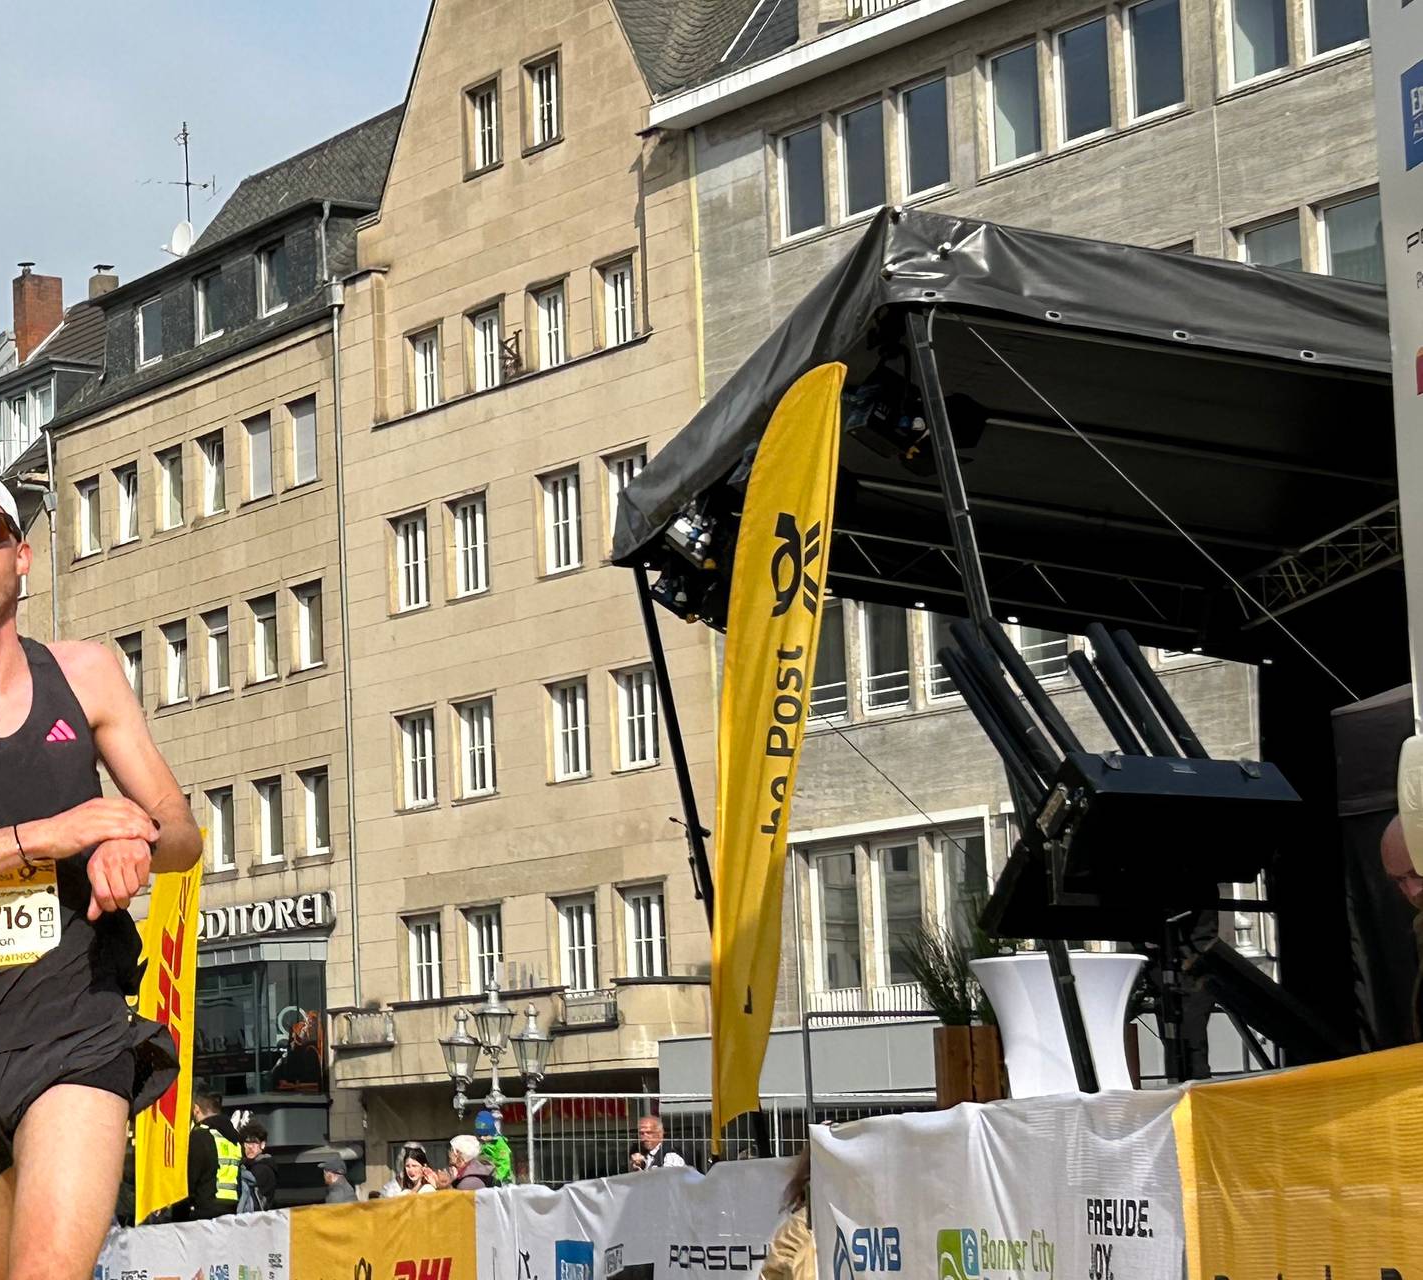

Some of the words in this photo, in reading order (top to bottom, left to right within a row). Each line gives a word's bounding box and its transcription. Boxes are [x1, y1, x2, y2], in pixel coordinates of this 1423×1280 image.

[765, 643, 804, 759] Post
[1087, 1198, 1154, 1238] FREUDE.
[669, 1243, 768, 1271] PORSCH
[852, 1227, 902, 1272] SWB
[981, 1228, 1028, 1270] Bonner
[1031, 1228, 1055, 1280] City
